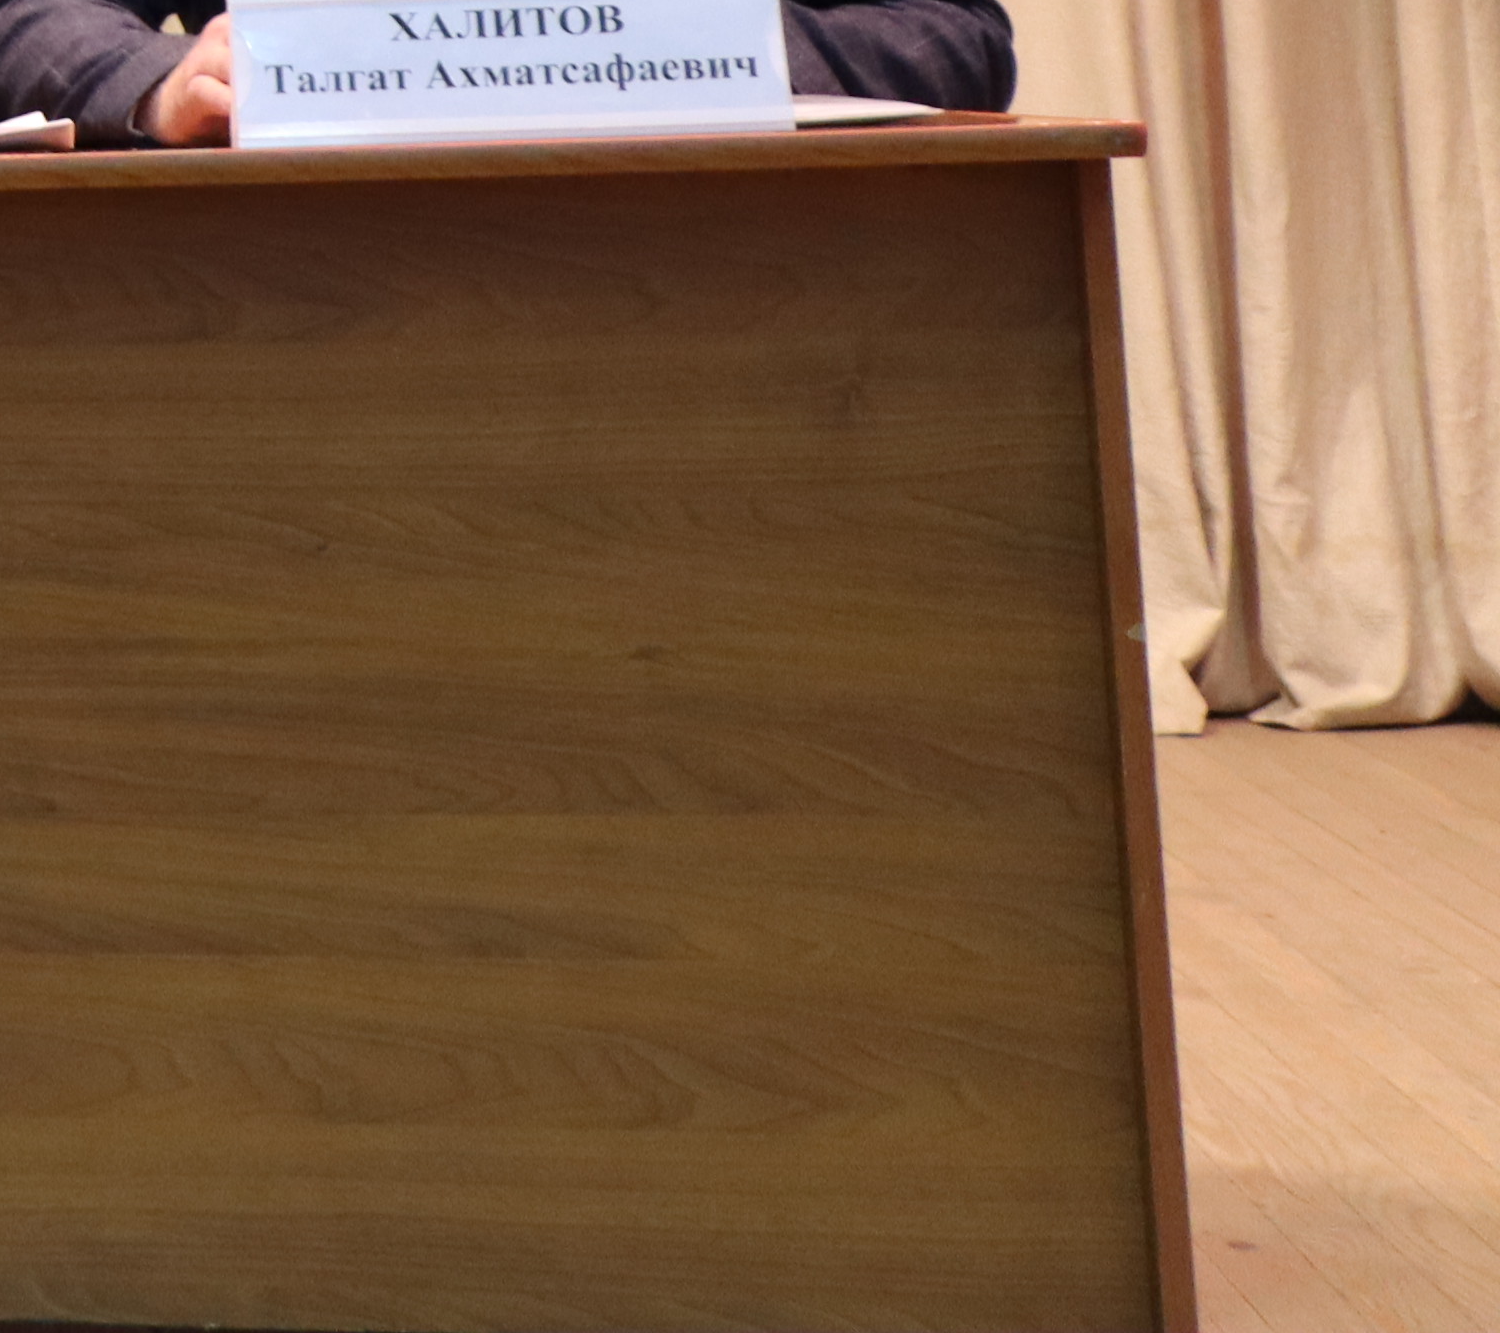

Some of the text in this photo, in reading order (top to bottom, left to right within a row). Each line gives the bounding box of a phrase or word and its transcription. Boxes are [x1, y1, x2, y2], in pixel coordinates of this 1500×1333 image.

[390, 5, 624, 41] ХАЛИТОВ
[264, 53, 758, 95] Талгат Ахматсафаевич
